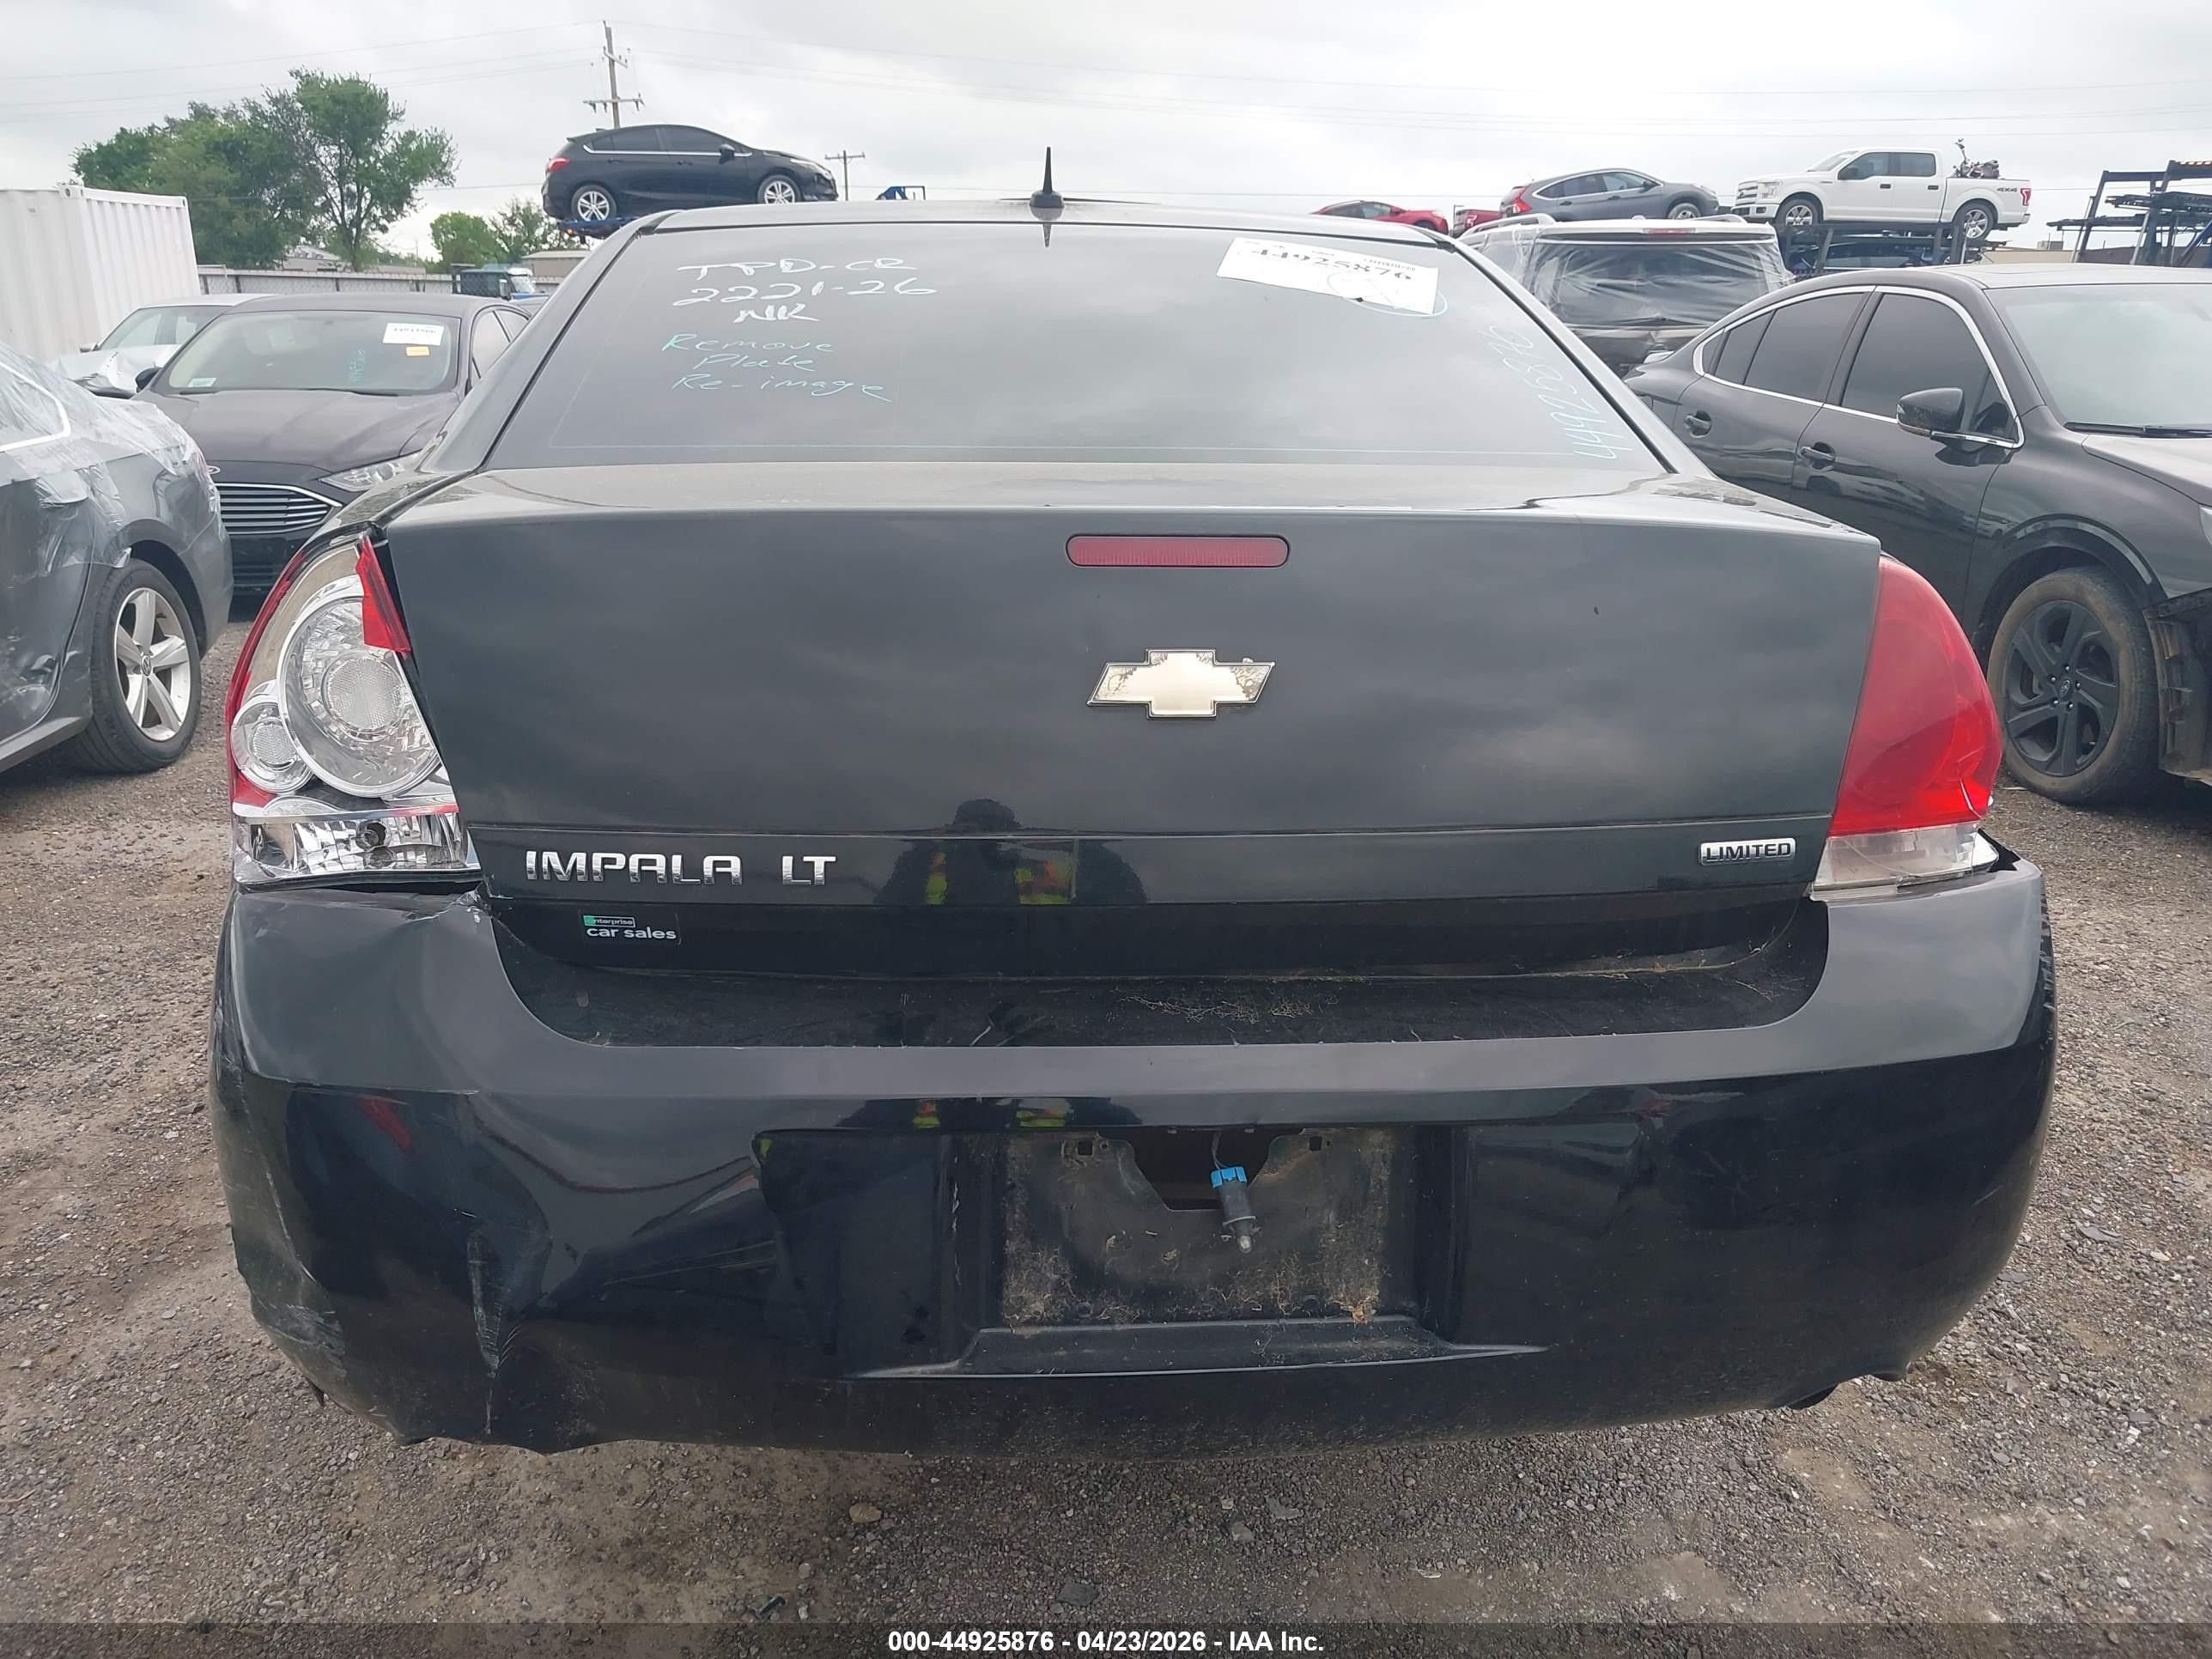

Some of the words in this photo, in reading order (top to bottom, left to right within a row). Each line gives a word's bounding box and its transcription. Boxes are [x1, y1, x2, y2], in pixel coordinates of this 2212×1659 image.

[662, 334, 834, 352] Remove
[694, 355, 815, 371] Plate
[1706, 843, 1791, 860] LIMITED
[526, 850, 743, 885] IMPALA
[782, 855, 836, 886] LT
[586, 927, 618, 939] car
[623, 927, 677, 940] sales
